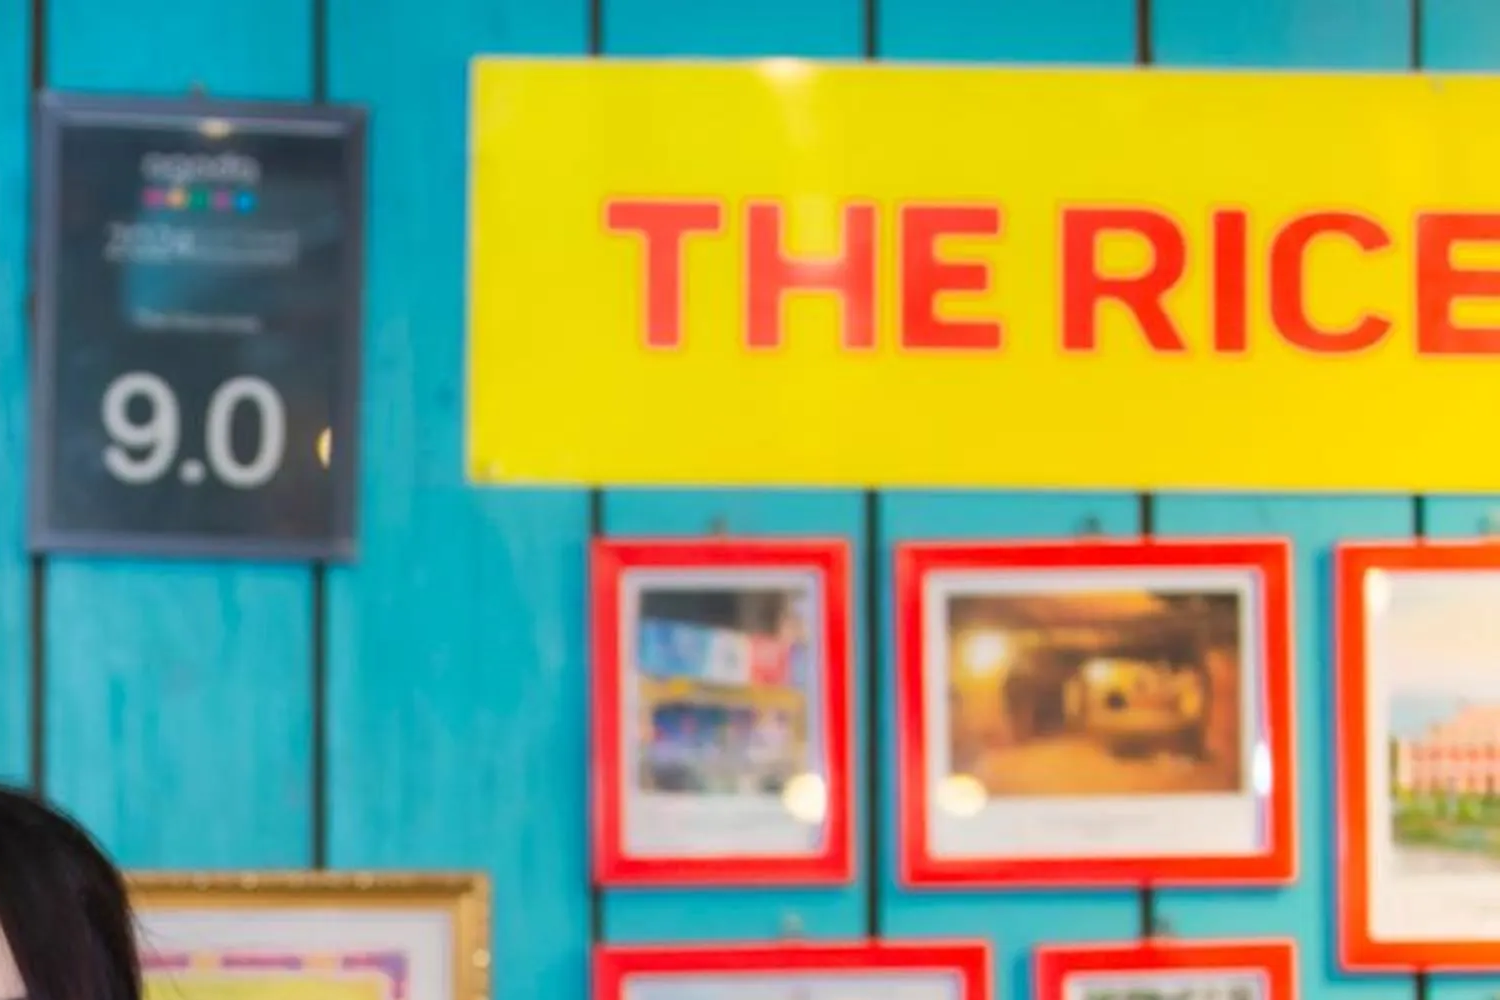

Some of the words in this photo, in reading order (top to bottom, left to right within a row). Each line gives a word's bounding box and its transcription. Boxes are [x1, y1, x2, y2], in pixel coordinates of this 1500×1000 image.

[604, 200, 1002, 350] THE
[1062, 206, 1500, 355] RICE
[102, 371, 287, 489] 9.0
